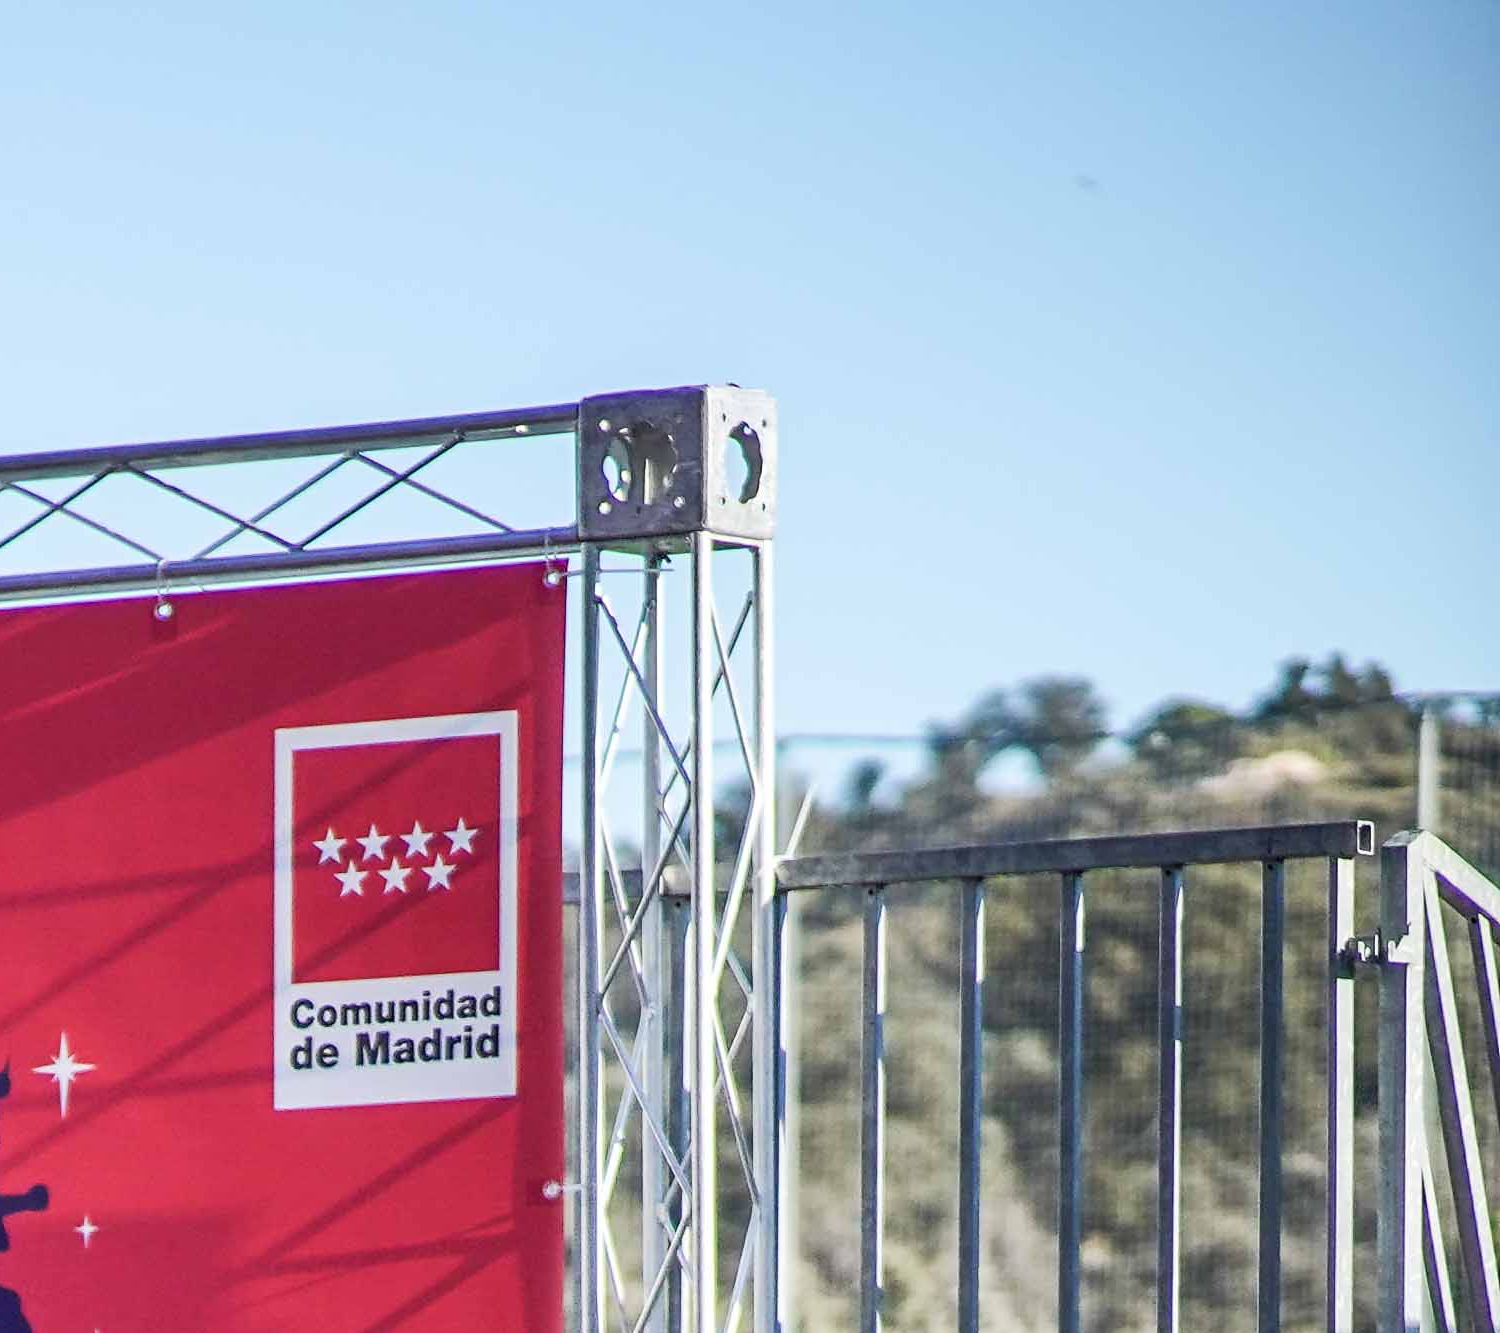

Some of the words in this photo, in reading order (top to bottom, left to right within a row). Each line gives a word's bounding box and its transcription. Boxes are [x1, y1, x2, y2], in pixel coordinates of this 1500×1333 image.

[288, 985, 502, 1029] Comunidad
[289, 1035, 340, 1070] de
[355, 1023, 501, 1066] Madrid
